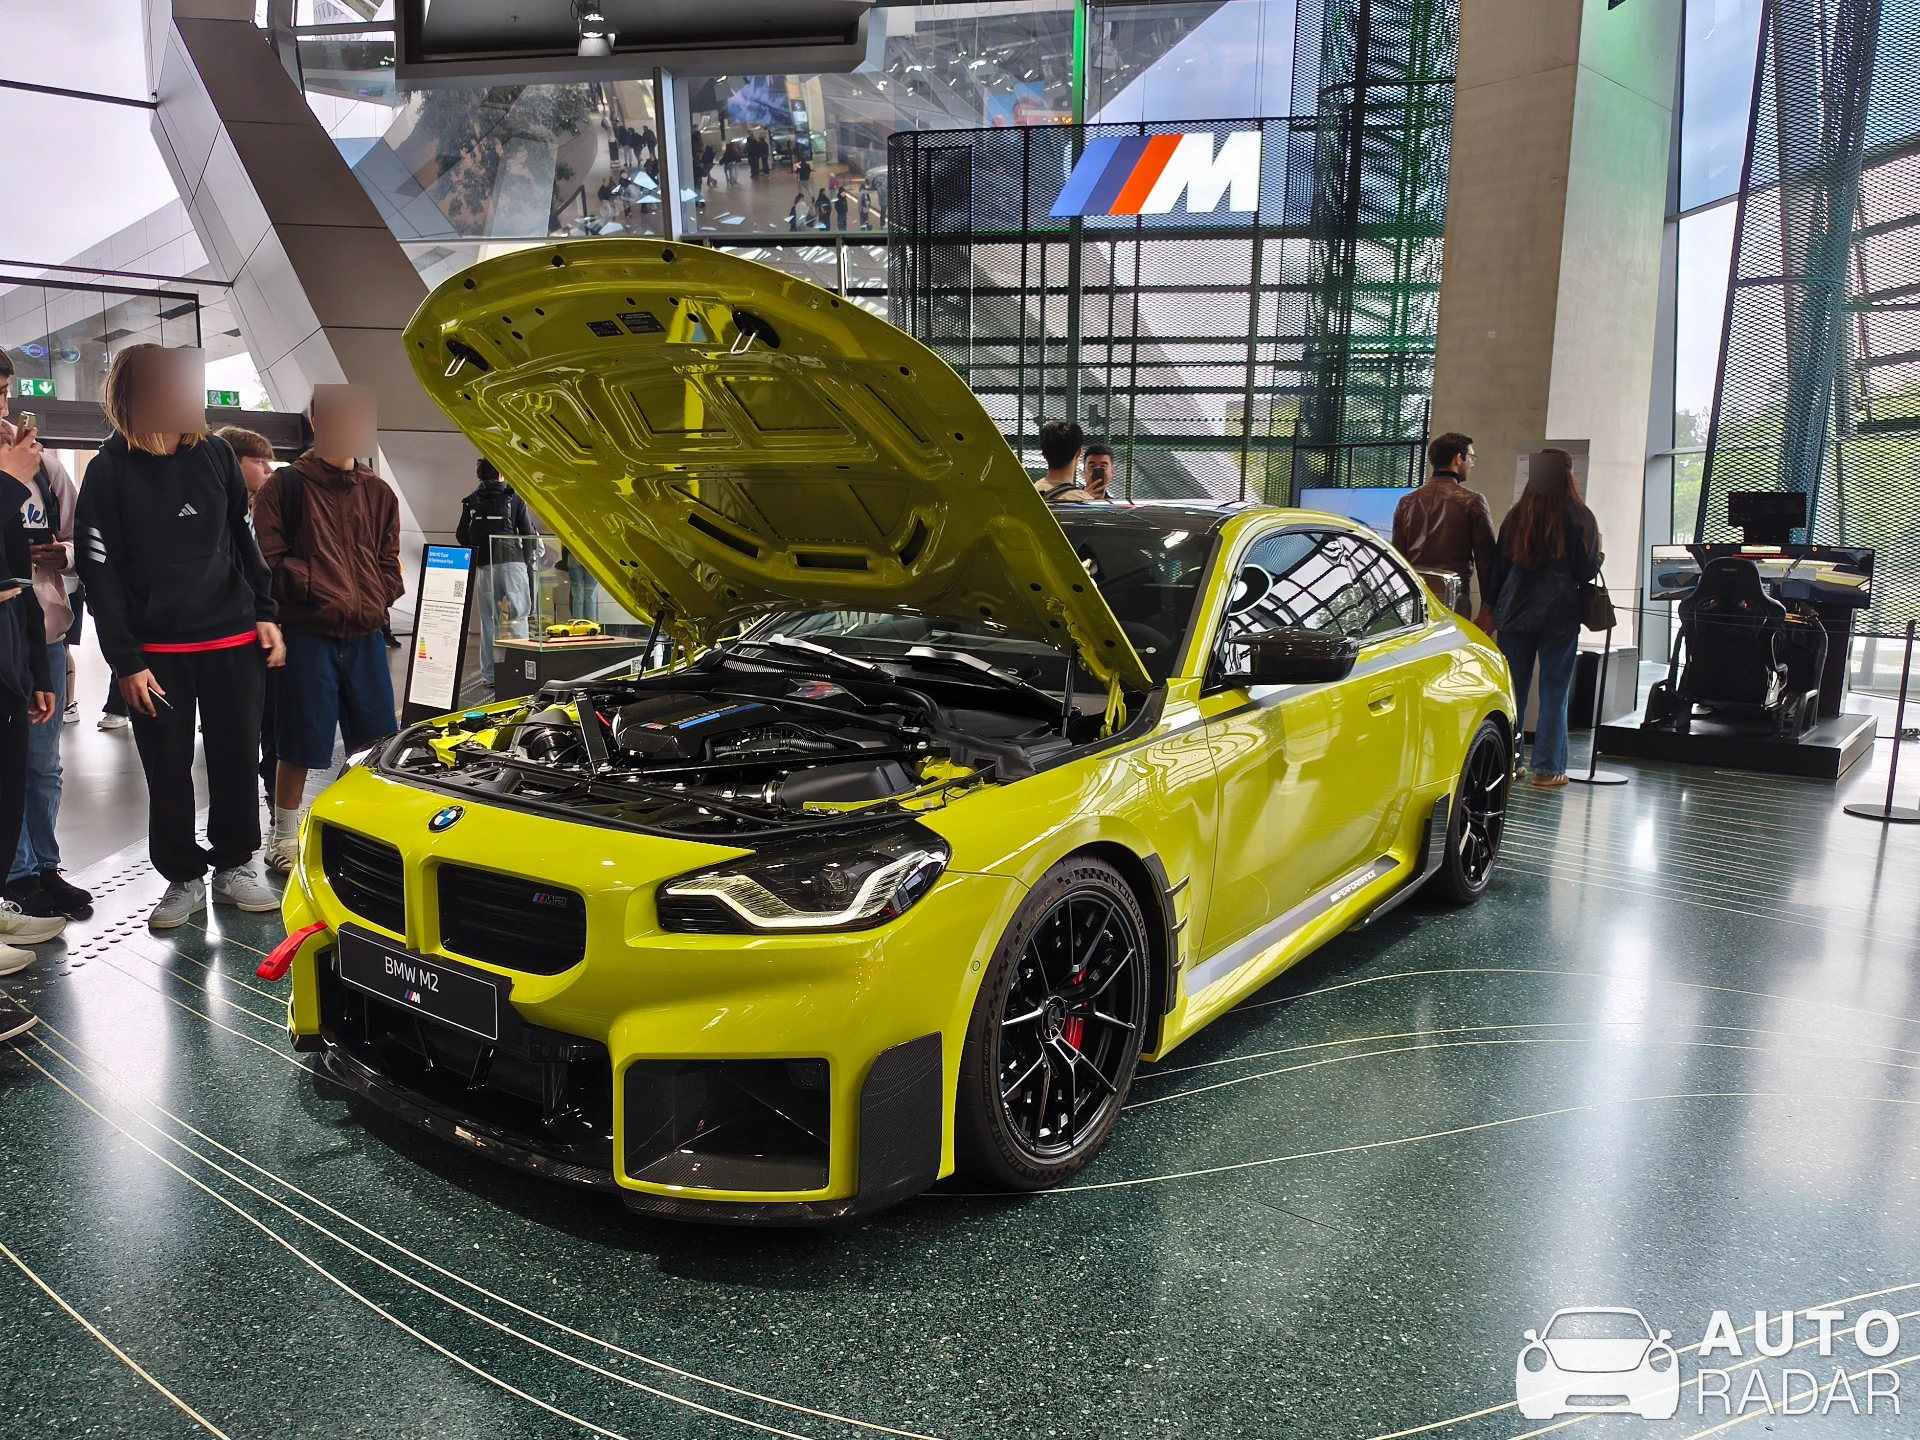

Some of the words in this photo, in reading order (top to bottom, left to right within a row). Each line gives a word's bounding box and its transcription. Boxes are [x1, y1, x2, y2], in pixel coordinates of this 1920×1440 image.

[1137, 130, 1262, 215] M
[384, 956, 416, 984] BMW
[419, 969, 440, 993] M2
